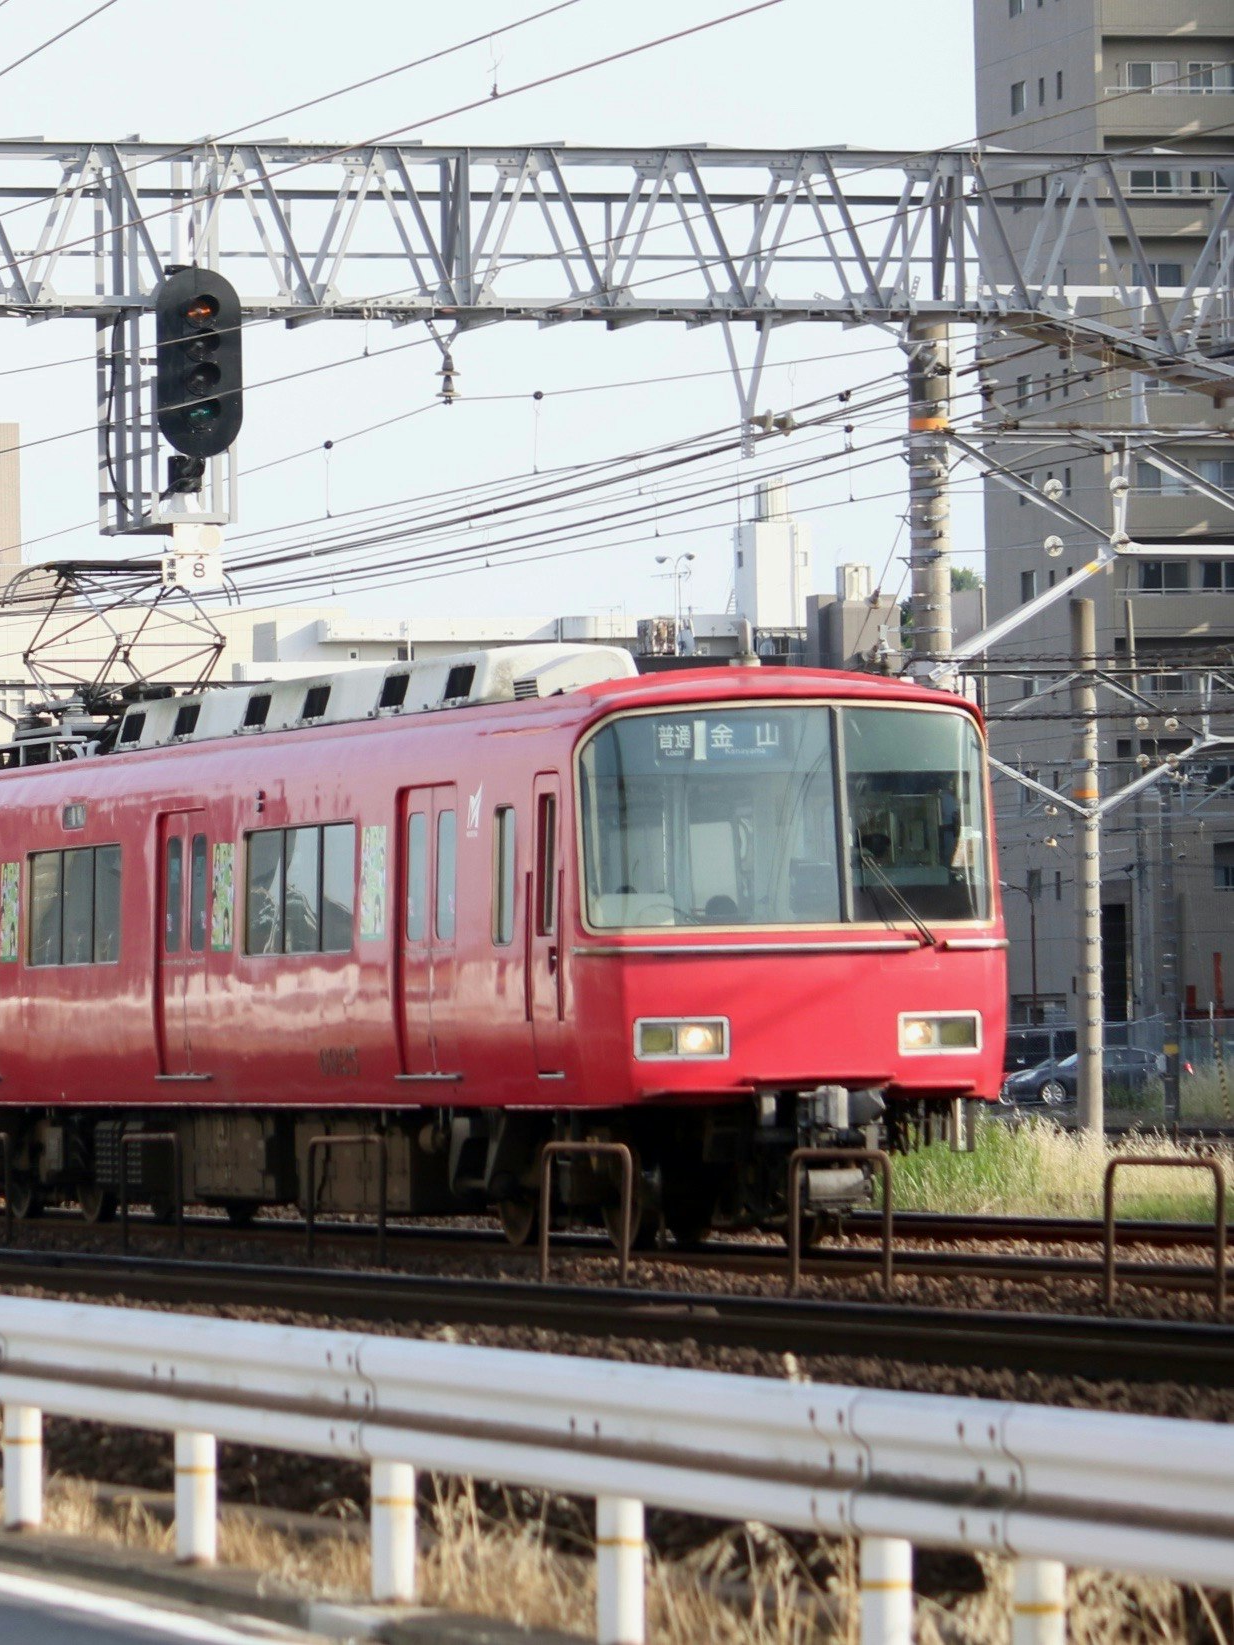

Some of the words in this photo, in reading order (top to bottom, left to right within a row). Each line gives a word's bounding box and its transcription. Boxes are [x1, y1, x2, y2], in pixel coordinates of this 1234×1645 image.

[193, 562, 206, 578] 8
[657, 724, 692, 749] 普通
[710, 723, 780, 748] 金山
